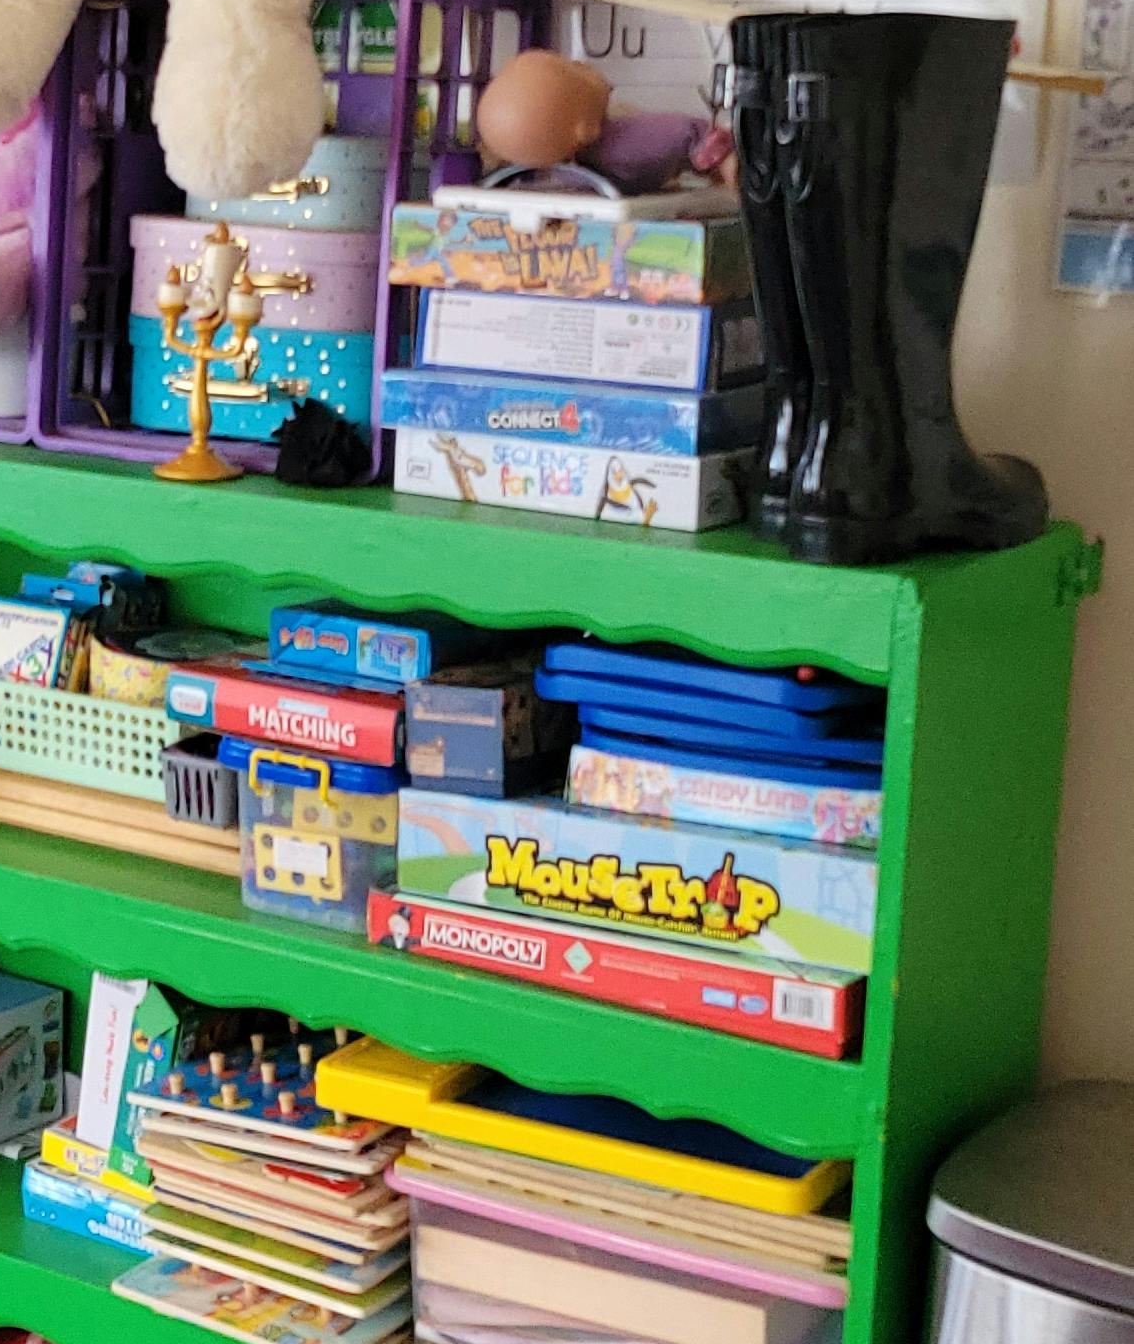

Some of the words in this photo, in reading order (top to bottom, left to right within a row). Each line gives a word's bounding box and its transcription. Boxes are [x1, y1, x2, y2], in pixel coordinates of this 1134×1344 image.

[579, 3, 647, 58] Uu
[488, 410, 559, 431] CONNECT
[558, 400, 580, 434] 4
[493, 442, 590, 474] SEQUENCE
[501, 463, 535, 497] for
[539, 464, 584, 497] kids
[248, 704, 356, 747] MATCHING
[677, 777, 750, 803] CANDY
[755, 785, 810, 812] LAND
[428, 923, 541, 963] MONOPOLY
